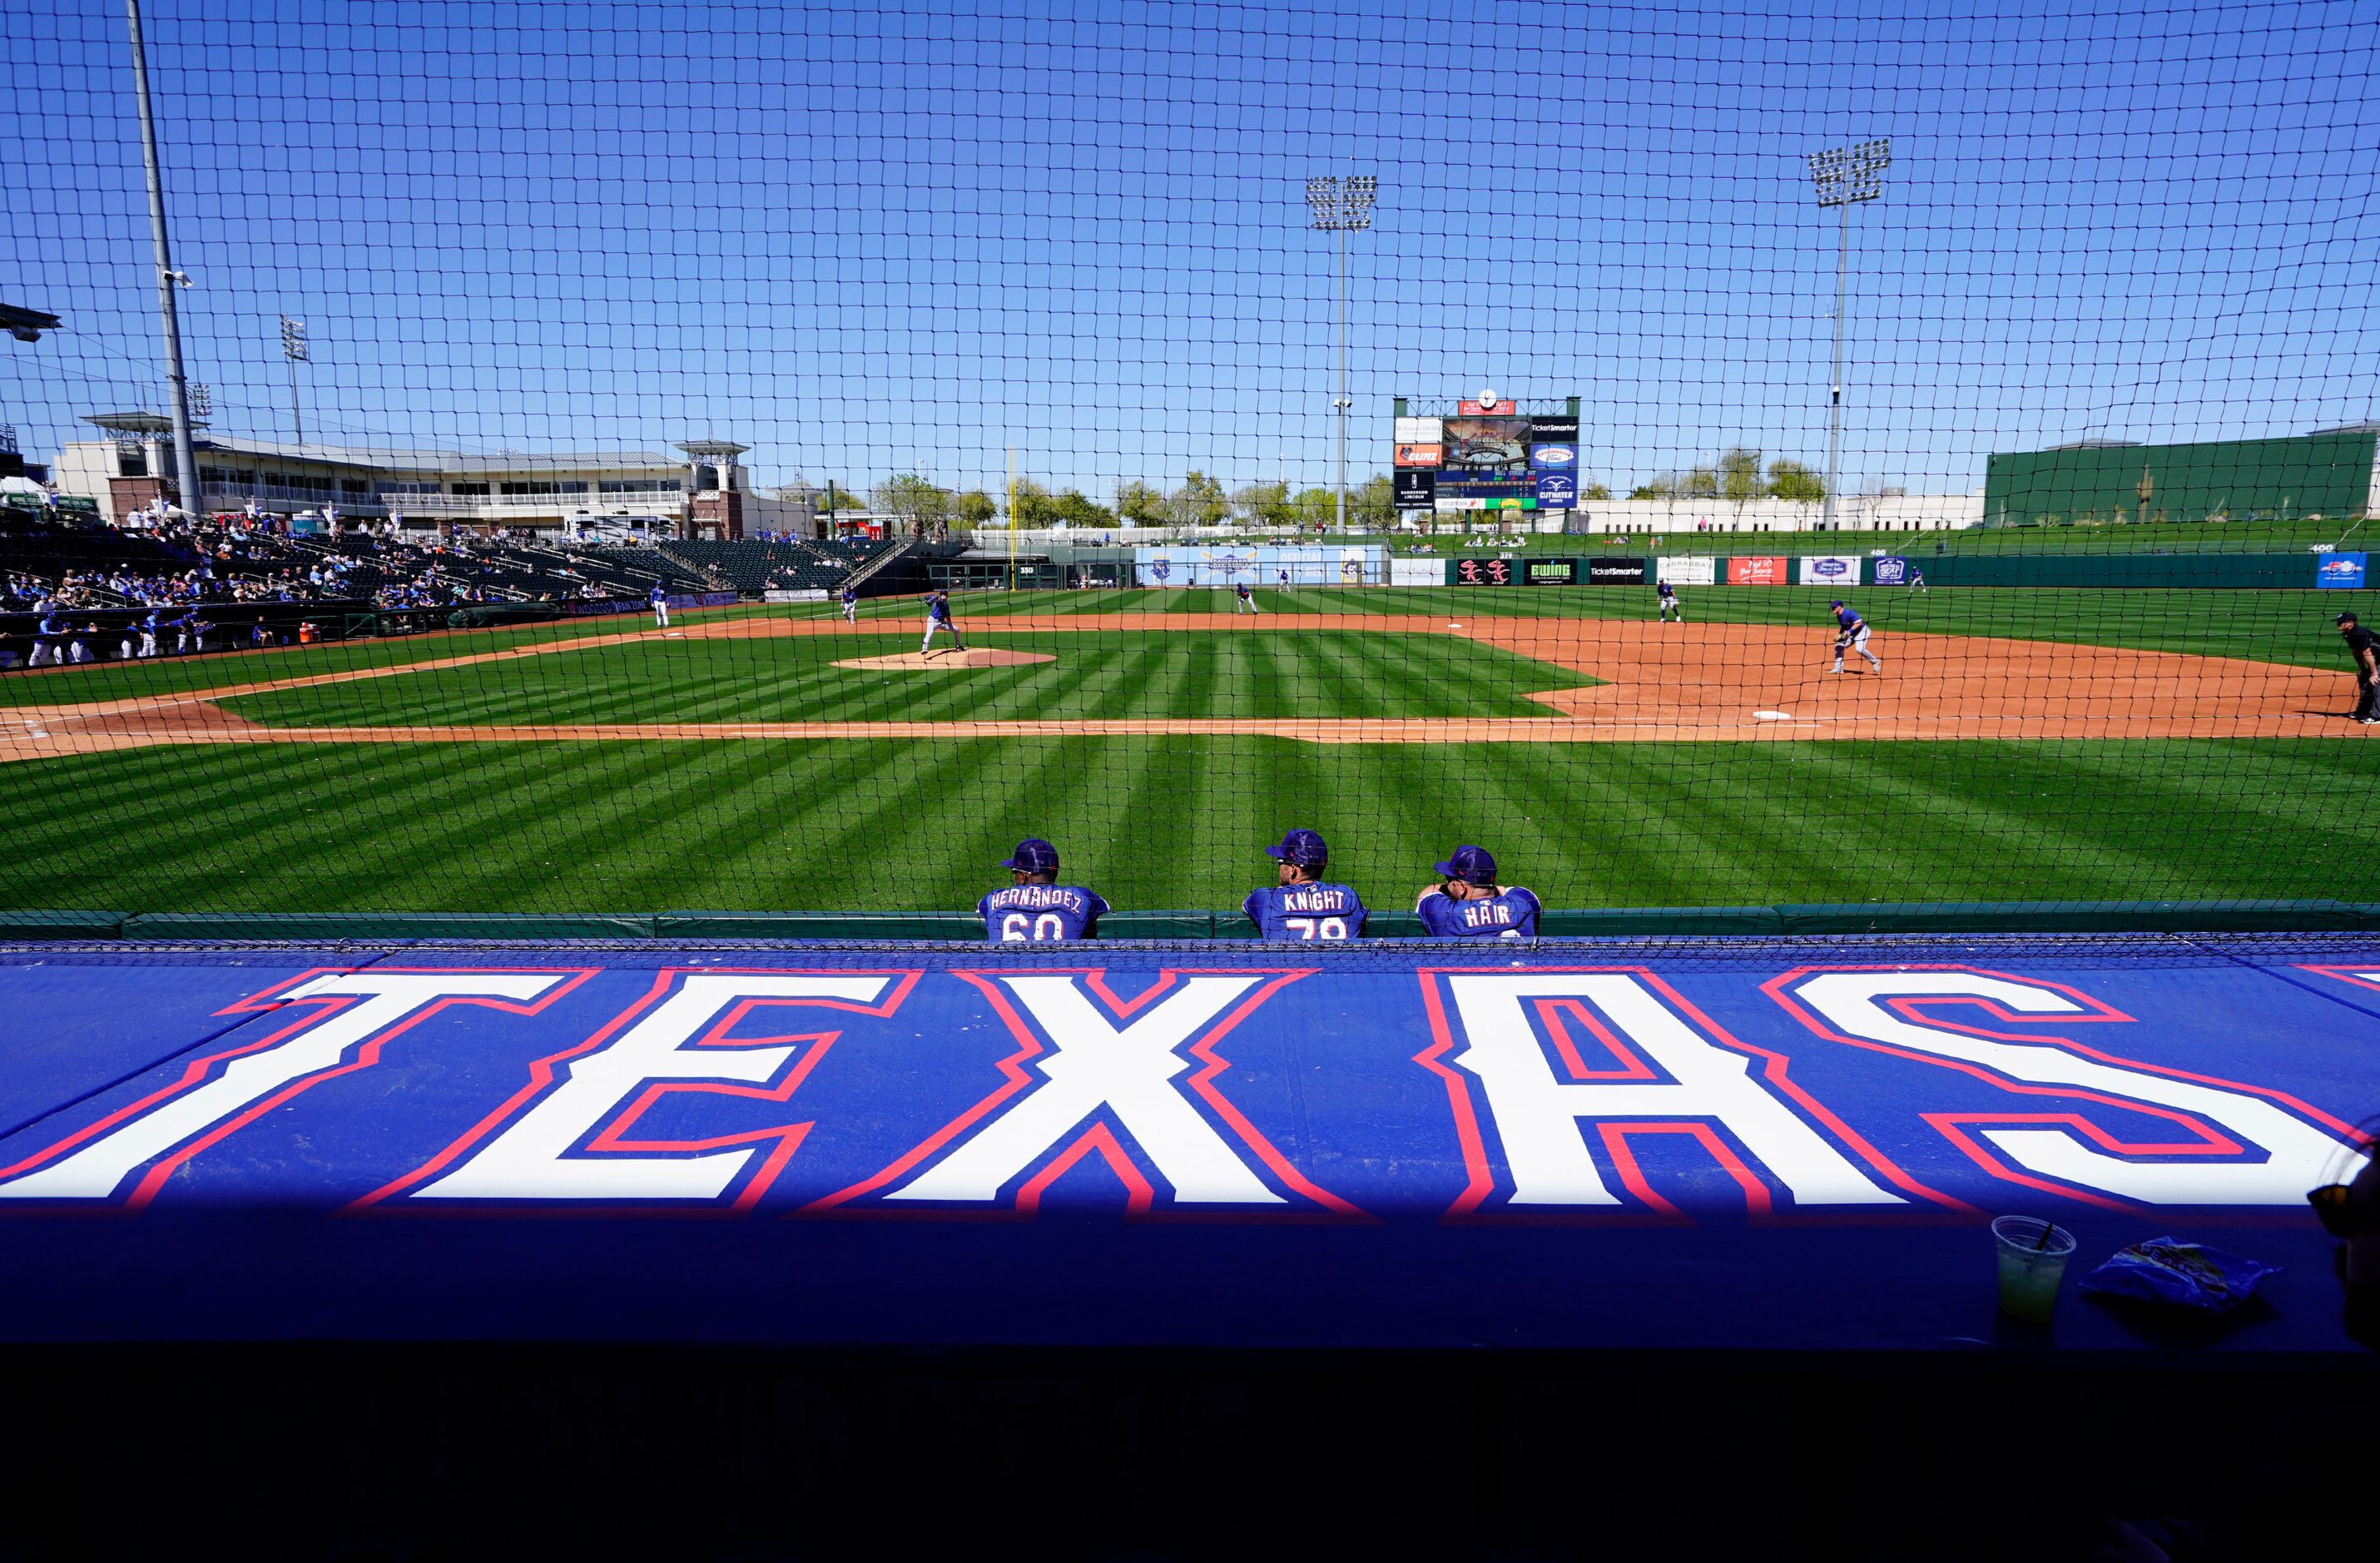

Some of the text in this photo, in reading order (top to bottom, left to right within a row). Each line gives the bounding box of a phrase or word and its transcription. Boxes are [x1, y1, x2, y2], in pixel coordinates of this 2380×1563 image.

[1591, 568, 1644, 576] TicketSmarter
[617, 601, 632, 613] FAN
[1284, 891, 1344, 911] KNIGHT
[1464, 905, 1510, 927] HAIR
[0, 967, 2373, 1211] TEXAS
